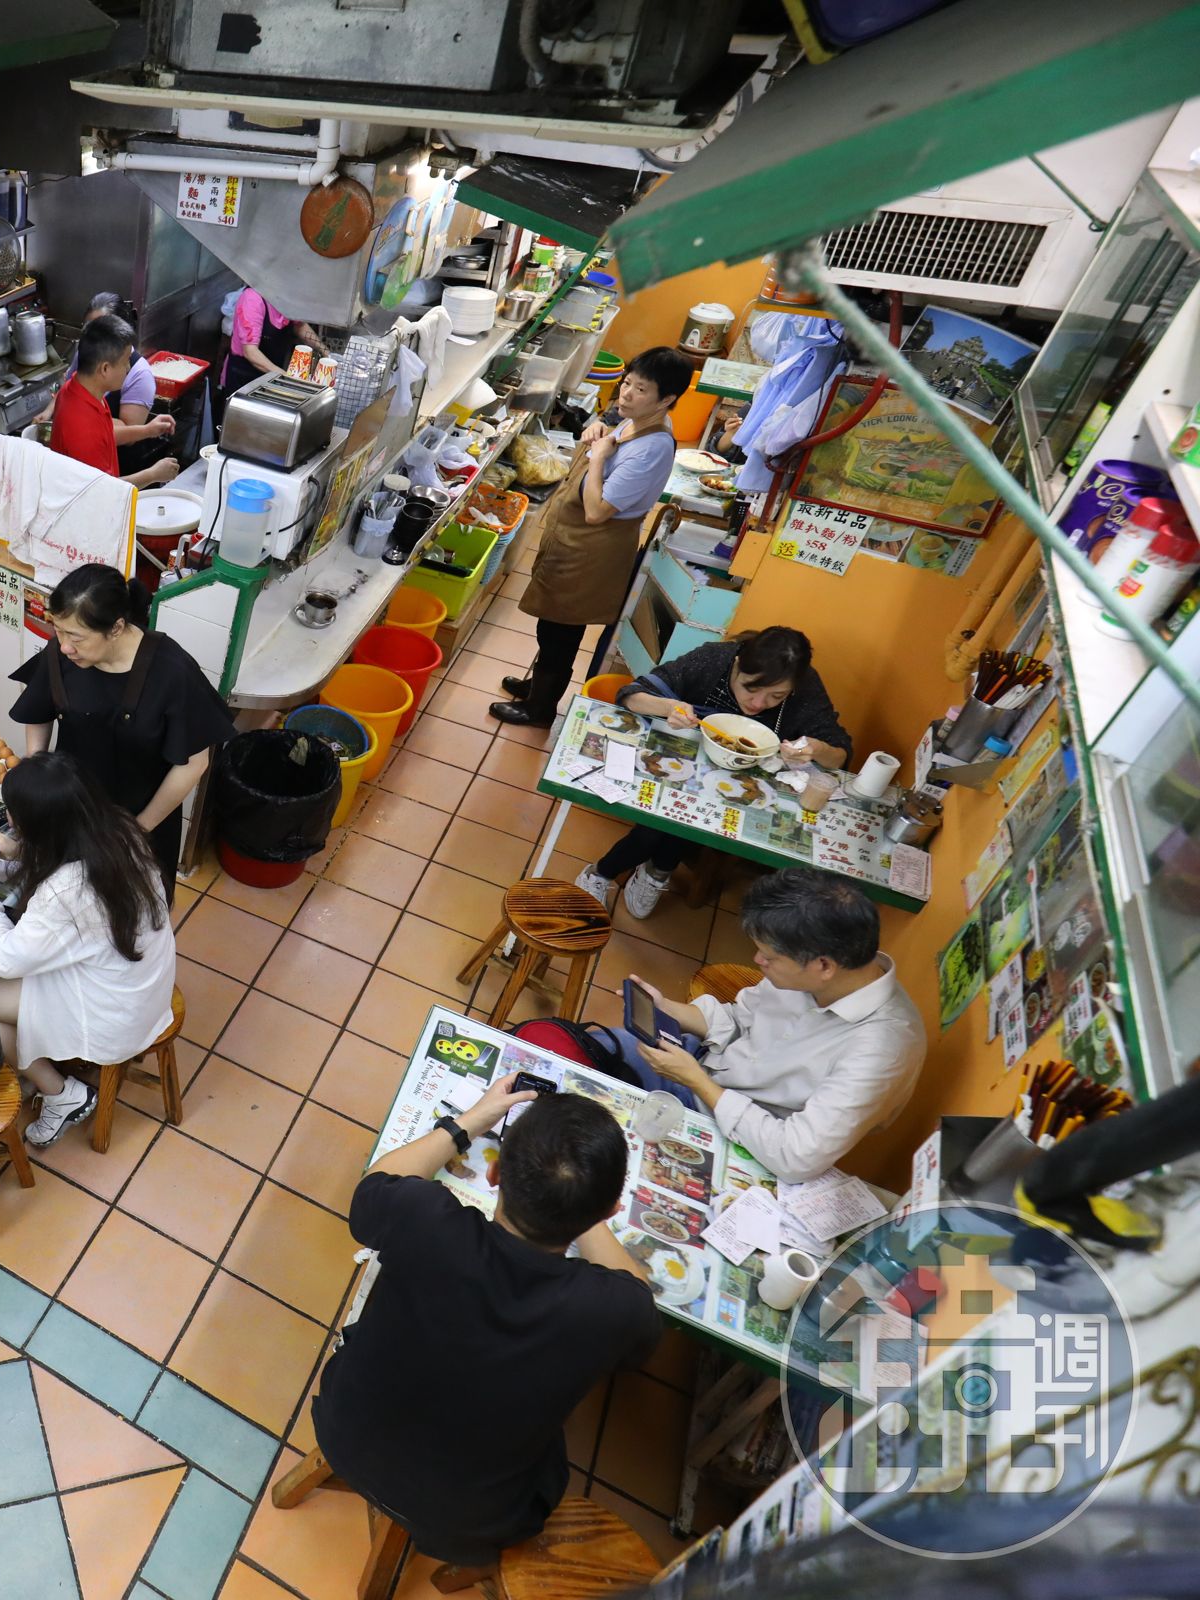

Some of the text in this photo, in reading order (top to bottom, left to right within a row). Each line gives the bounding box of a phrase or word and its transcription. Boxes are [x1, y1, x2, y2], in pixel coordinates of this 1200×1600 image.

[188, 187, 199, 200] 麵
[223, 175, 238, 215] 即炸豬扒
[218, 216, 234, 225] $40
[861, 417, 883, 428] YICK
[887, 414, 918, 423] LOONG
[797, 503, 867, 530] 最新出品
[779, 542, 794, 557] 送
[805, 540, 827, 551] $58
